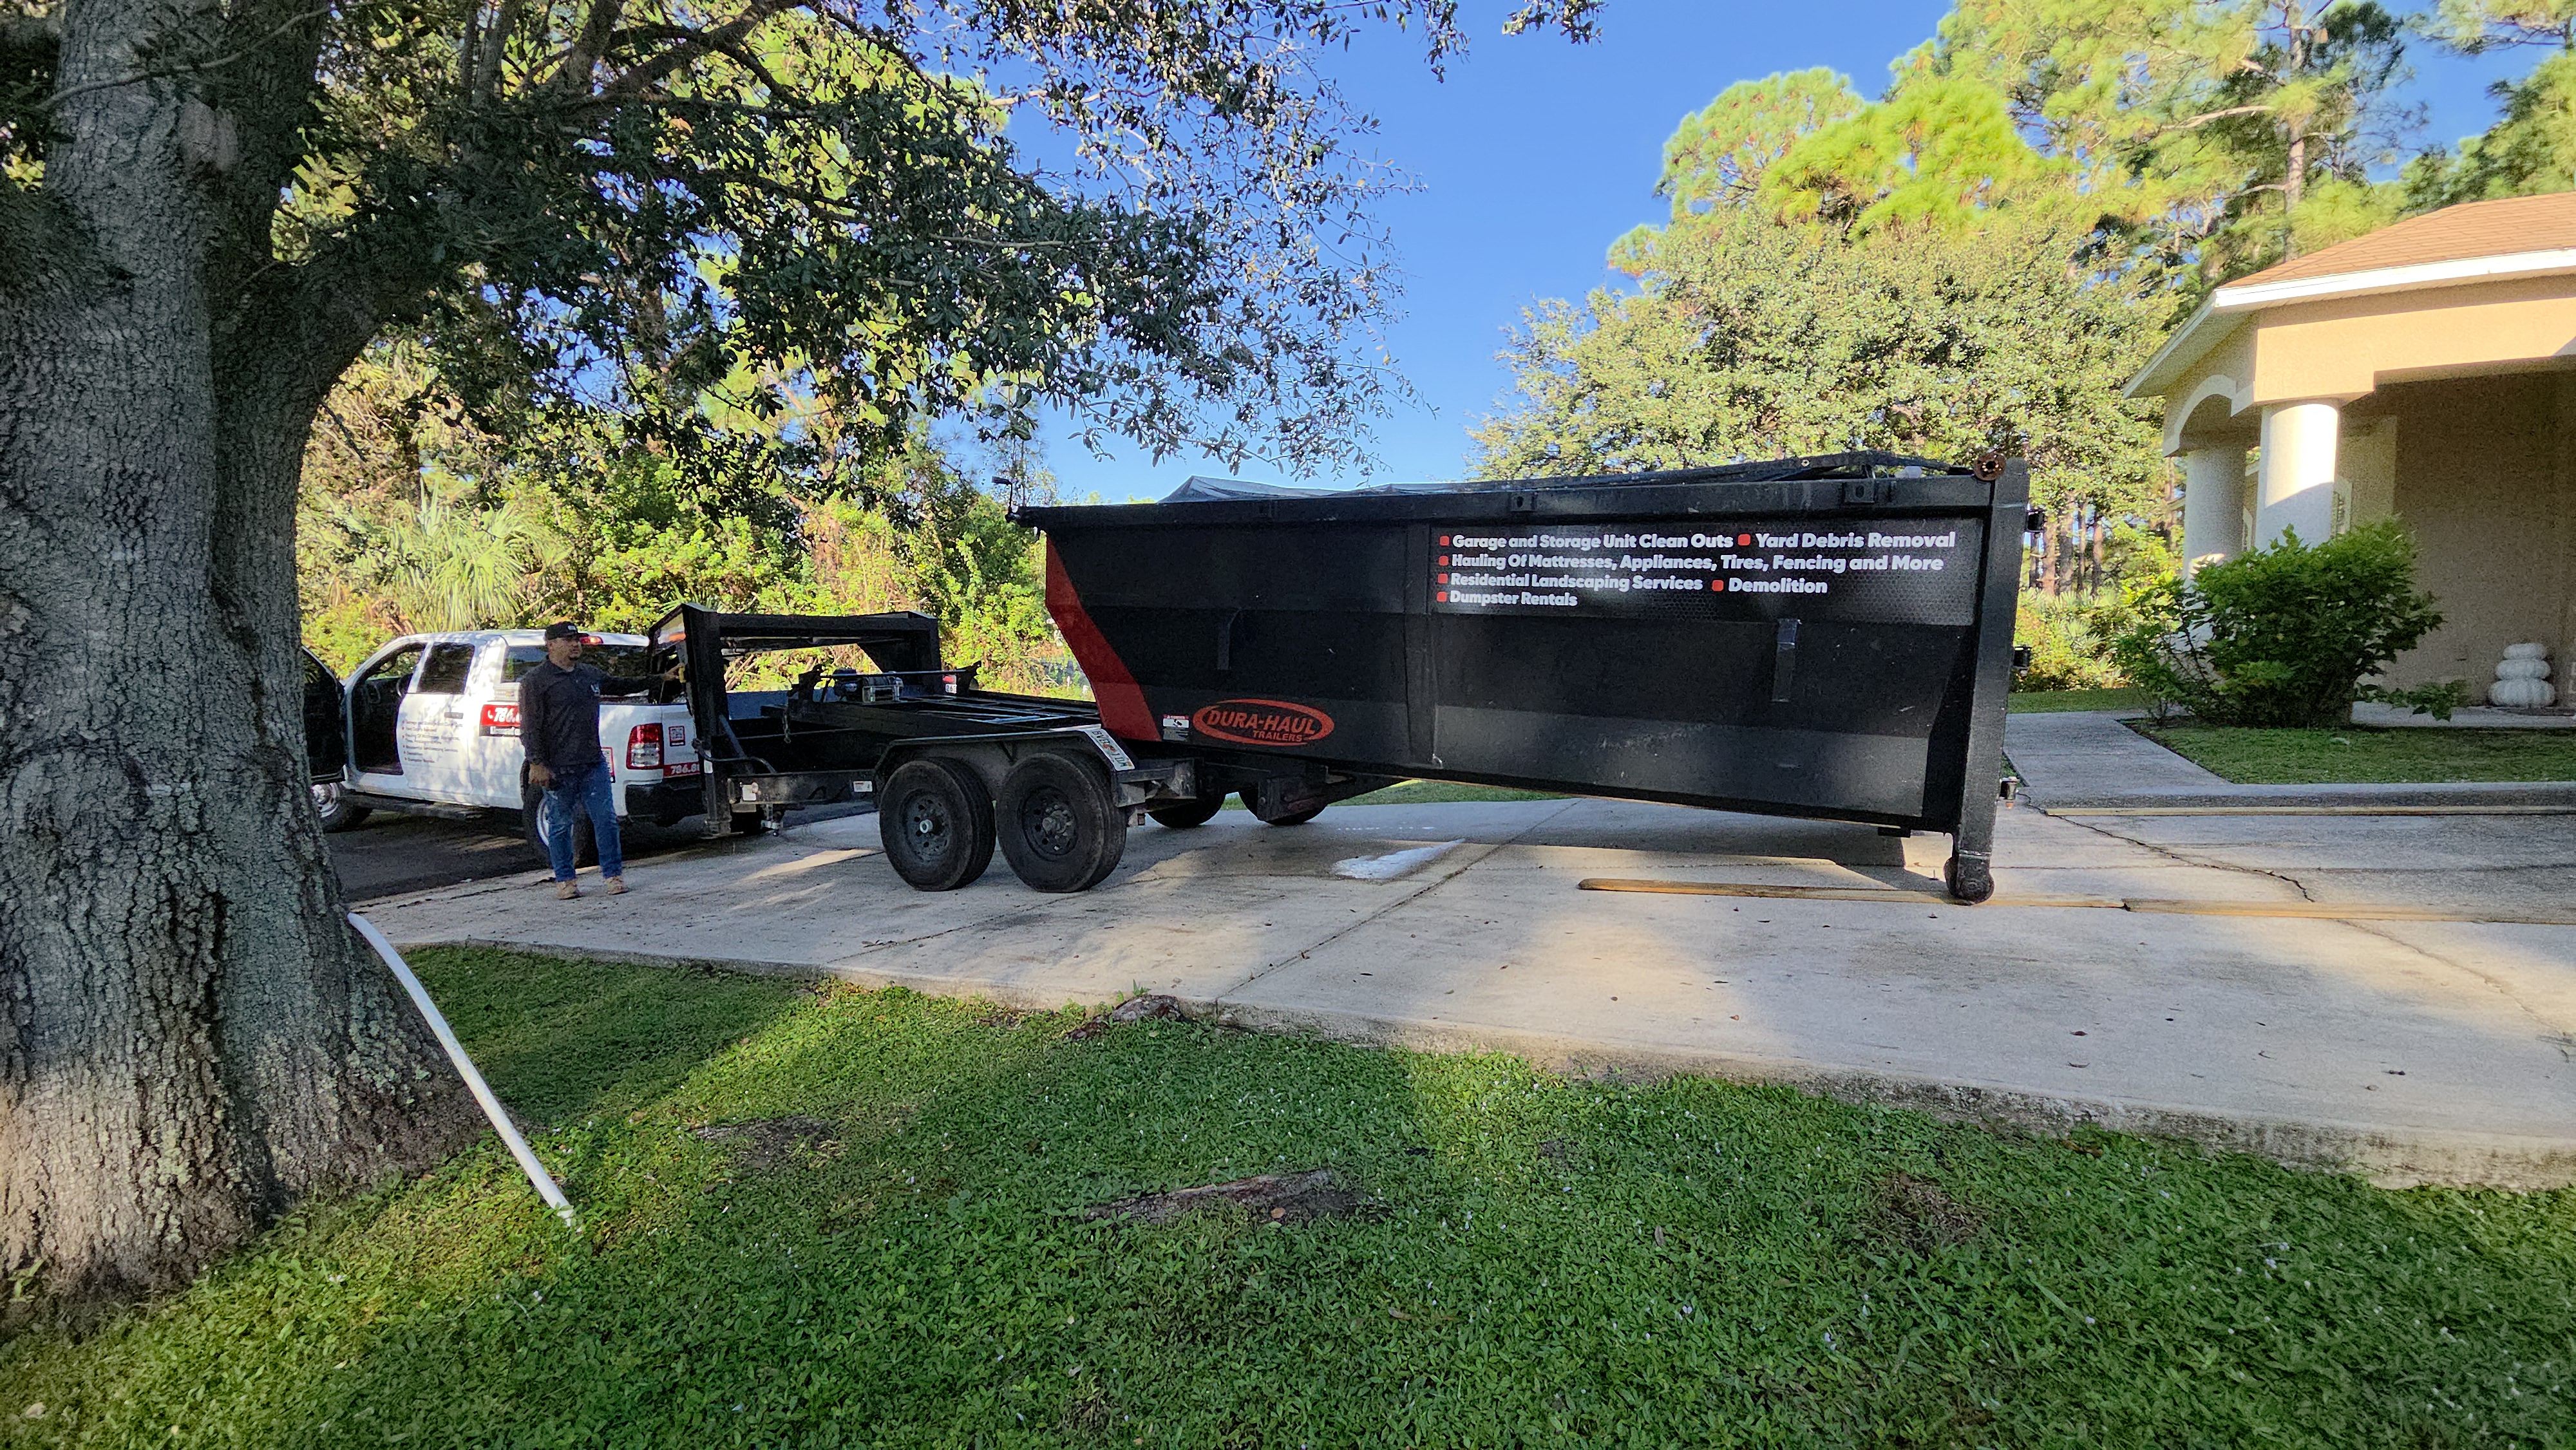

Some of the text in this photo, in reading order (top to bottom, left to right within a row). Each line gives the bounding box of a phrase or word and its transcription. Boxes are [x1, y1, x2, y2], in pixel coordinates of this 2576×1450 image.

[1452, 531, 1956, 551] Garage and Storage Unit Clean Outs Yard Debris Removal
[1452, 554, 1944, 573] Hauling Of Mattresses, Appliances, Tires, Fencing and More
[1450, 573, 1828, 593] Residential Landscaping Services Demolition
[1450, 590, 1578, 606] Dumpster Rentals
[1207, 710, 1316, 735] DURA-HAUL
[1253, 730, 1303, 742] TRAILERS
